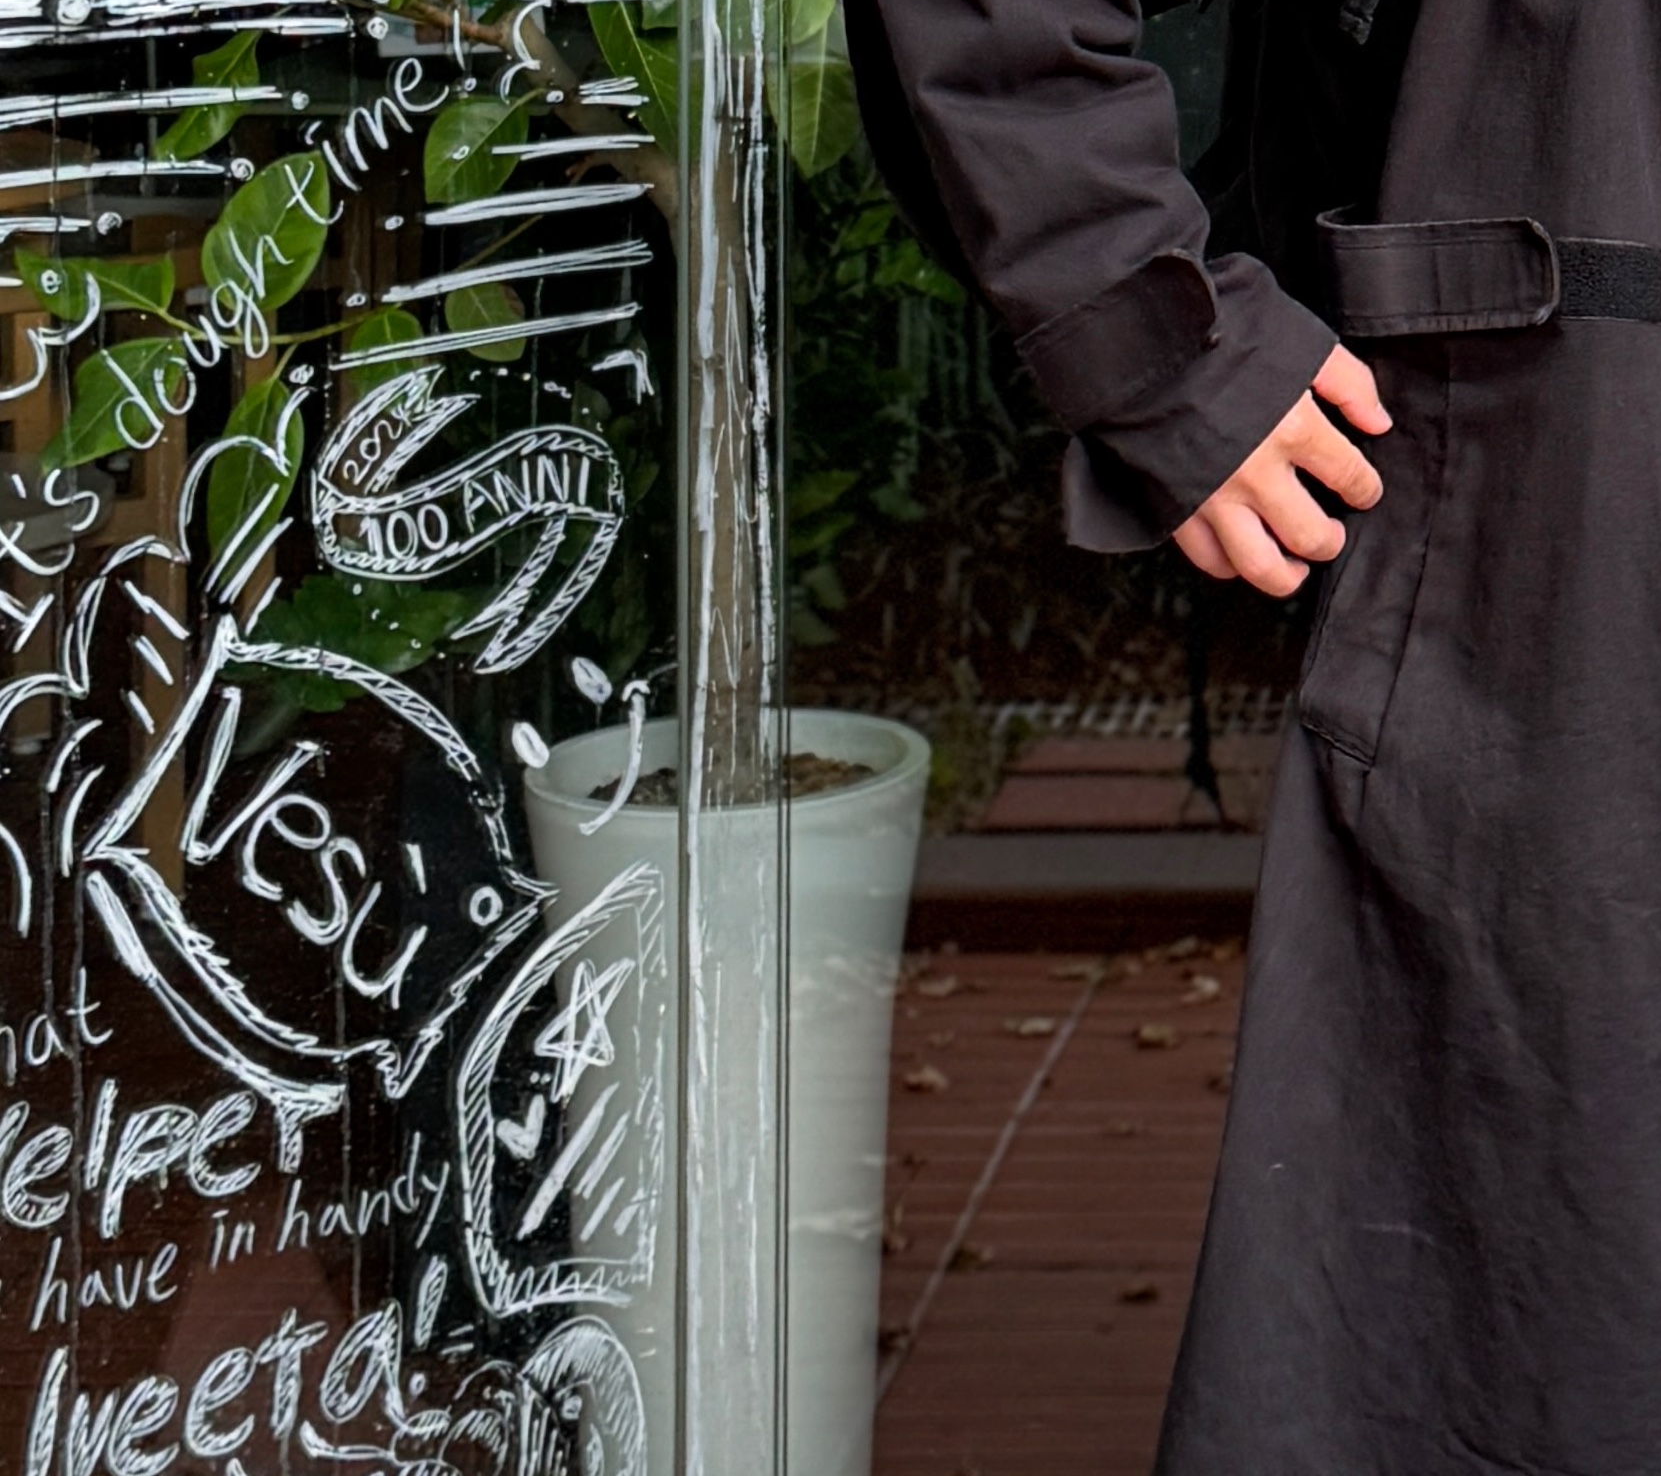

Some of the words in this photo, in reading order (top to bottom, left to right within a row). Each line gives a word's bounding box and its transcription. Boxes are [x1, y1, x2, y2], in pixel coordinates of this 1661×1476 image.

[102, 226, 294, 450] dough
[358, 504, 450, 561] 100
[462, 454, 592, 534] ANNI
[0, 1079, 346, 1240] elper
[30, 1236, 180, 1332] have
[209, 1209, 256, 1272] in
[276, 1131, 451, 1254] handy
